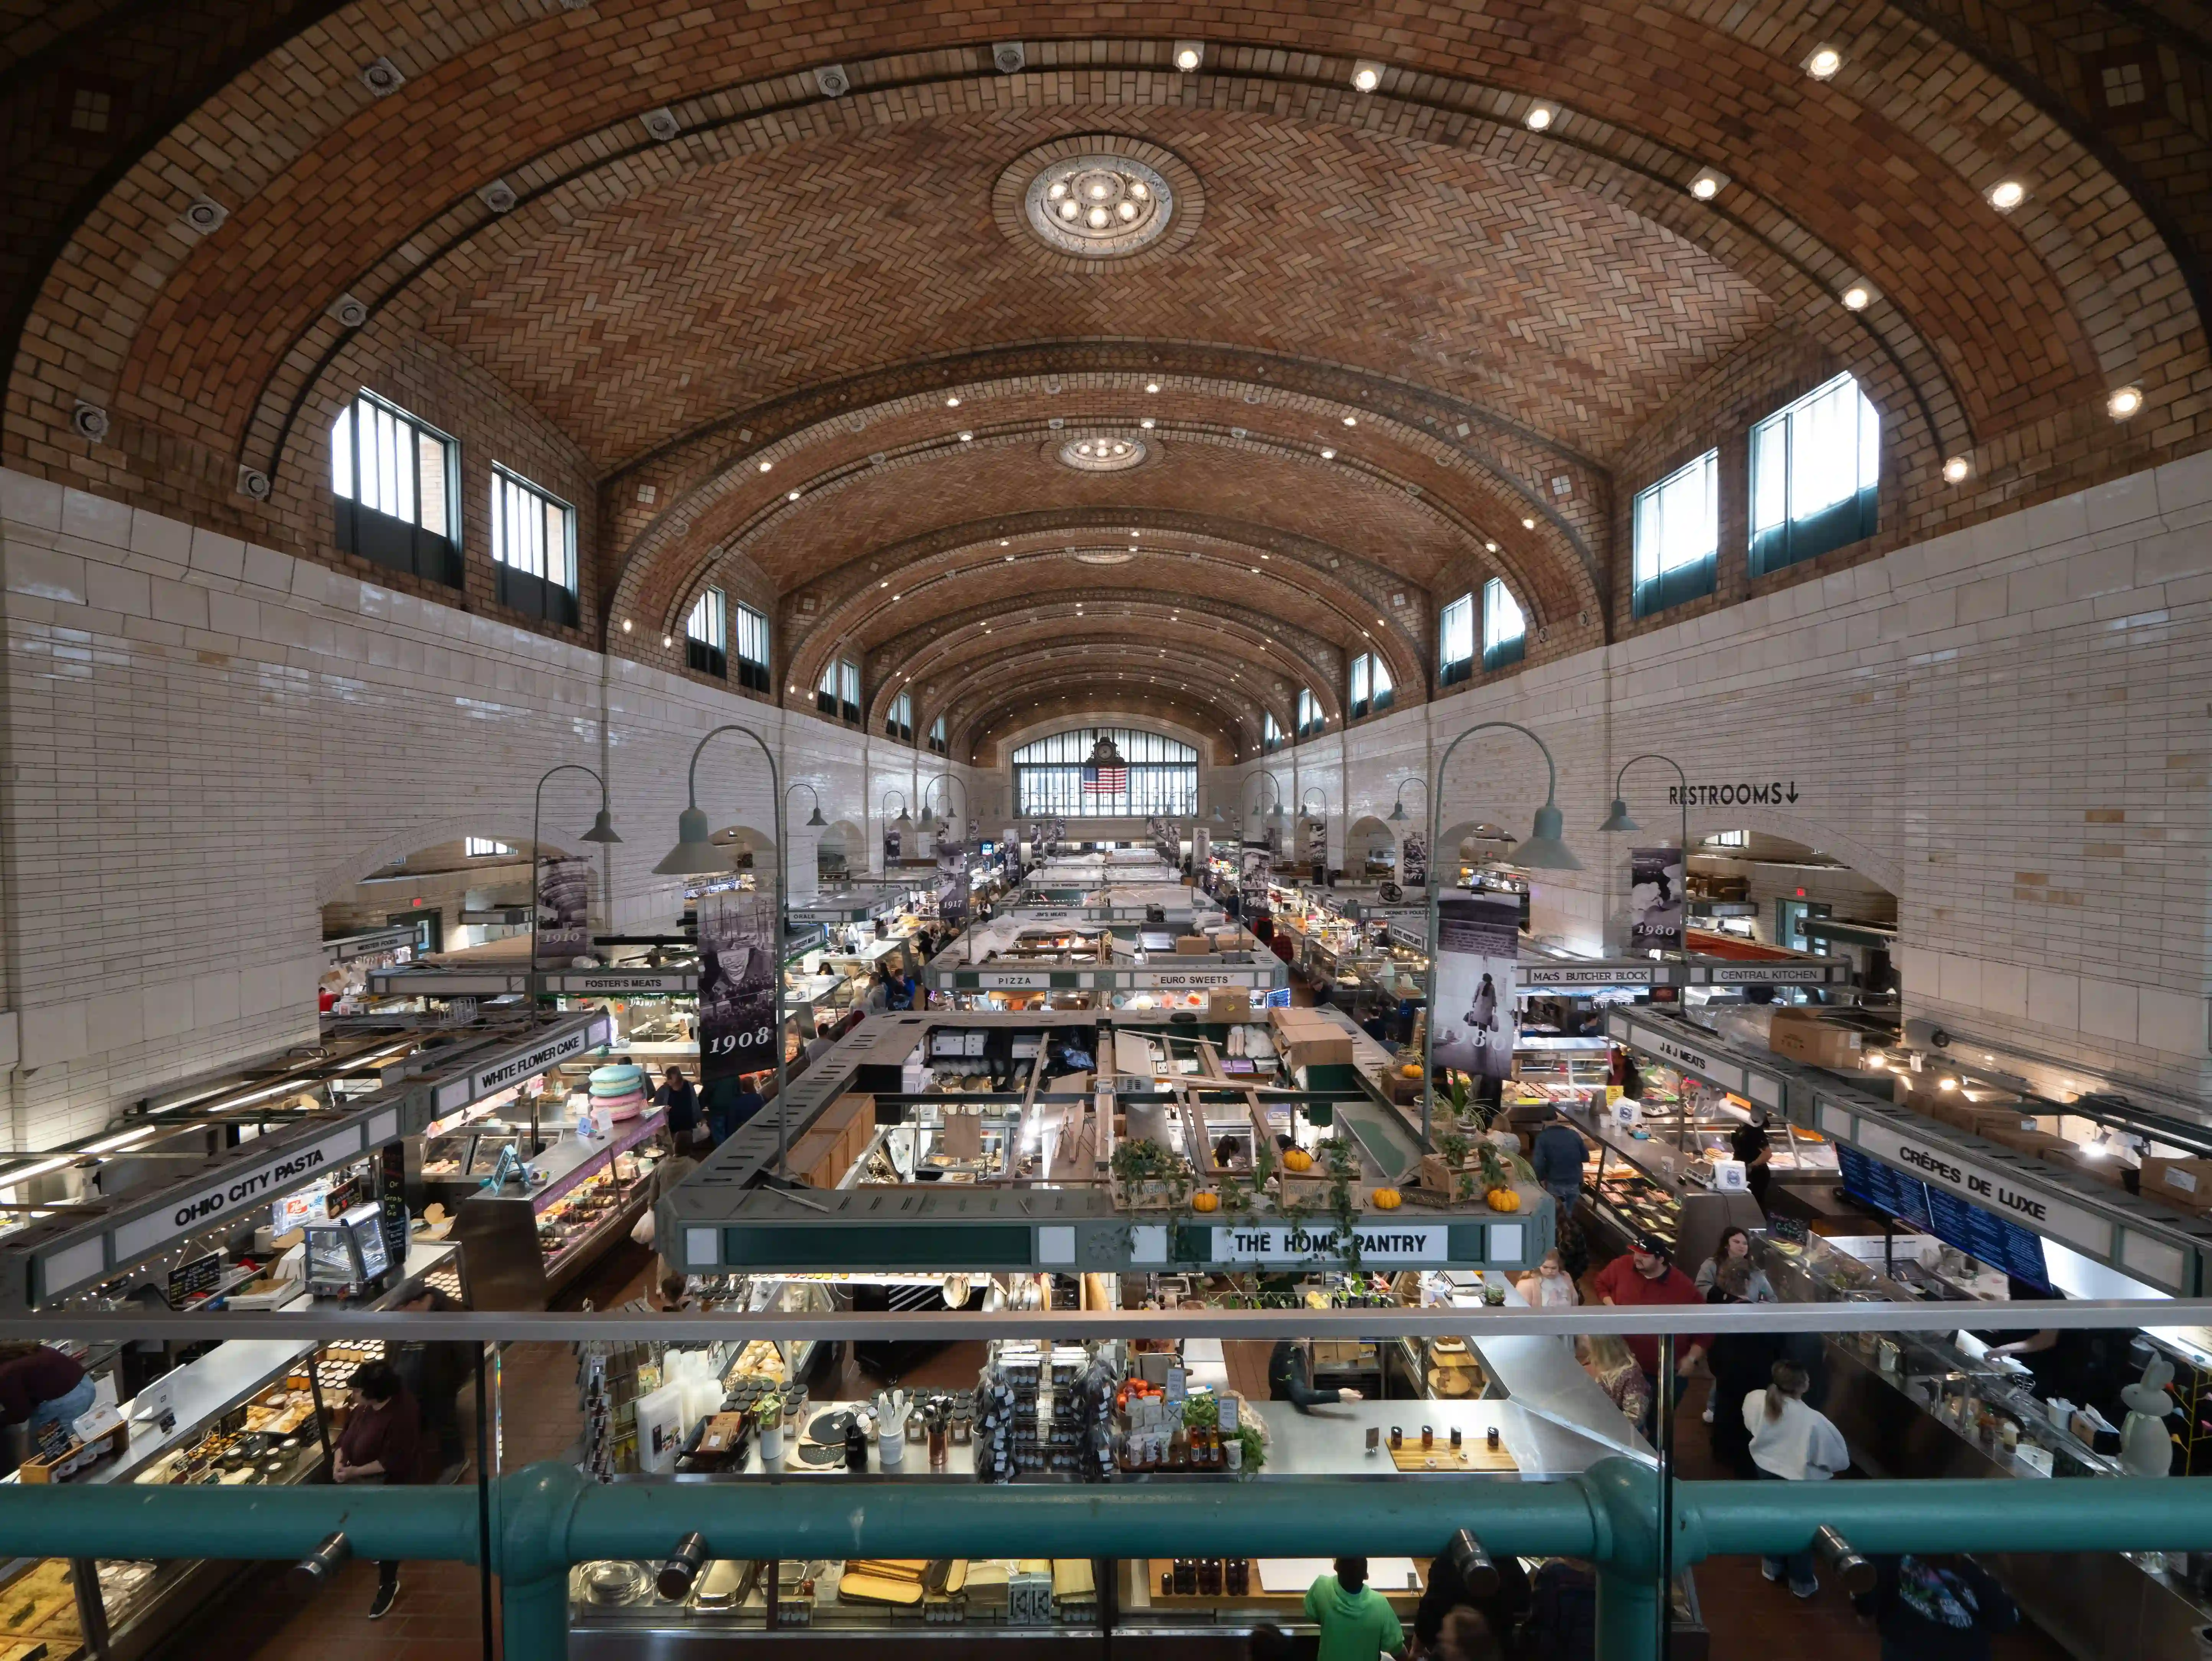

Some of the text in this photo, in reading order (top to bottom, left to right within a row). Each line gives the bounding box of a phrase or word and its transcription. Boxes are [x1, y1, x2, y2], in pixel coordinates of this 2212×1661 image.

[1670, 782, 1782, 805] RESTROOMS
[943, 900, 962, 909] 1917
[1637, 925, 1675, 936] 1980
[381, 939, 398, 947] FOODS
[545, 933, 579, 944] 1910
[1160, 976, 1228, 984] EURO SWEETS
[1566, 972, 1611, 981] BUTCHER
[1616, 971, 1648, 980] BLOCK
[1721, 971, 1818, 979] CENTRAL KITCHEN
[998, 977, 1031, 985] PIZZA
[709, 1027, 769, 1055] 1908
[1438, 1026, 1507, 1050] 1980
[1660, 1042, 1705, 1069] J & J MEATS
[482, 1036, 579, 1088] WHITE FLOWER CAKE
[175, 1149, 324, 1226] OHIO CITY PASTA
[1900, 1147, 2046, 1221] CRÊPES DE LUXE
[384, 1194, 402, 1202] Grab
[1235, 1235, 1271, 1252] THE
